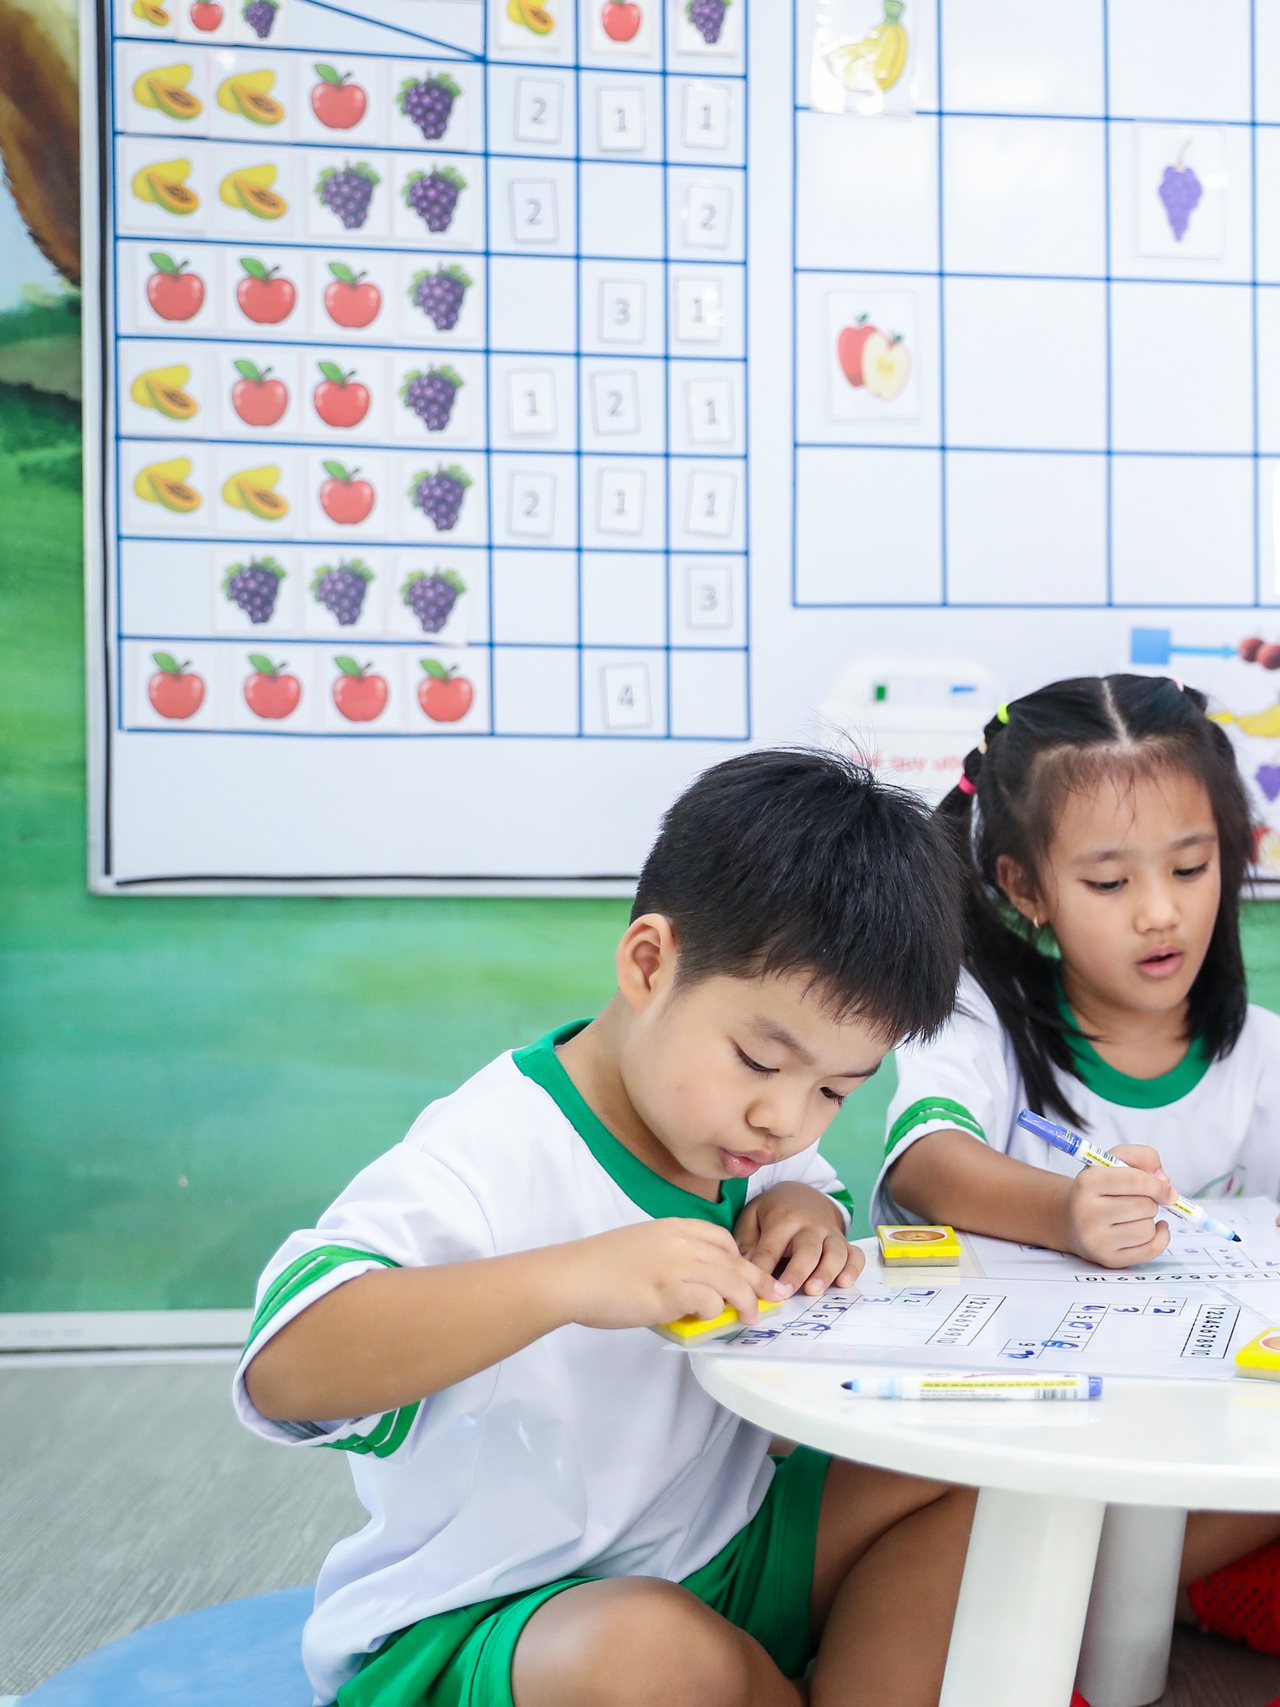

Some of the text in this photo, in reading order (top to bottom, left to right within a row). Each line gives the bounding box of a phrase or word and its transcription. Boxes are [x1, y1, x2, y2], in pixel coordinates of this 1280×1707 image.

[533, 97, 713, 133] 2 1 1
[527, 198, 716, 230] 2 2
[615, 298, 704, 326] 3 1
[528, 390, 718, 425] 1 2 1
[524, 489, 717, 518] 2 1 1
[702, 584, 717, 611] 3
[617, 683, 634, 708] 4
